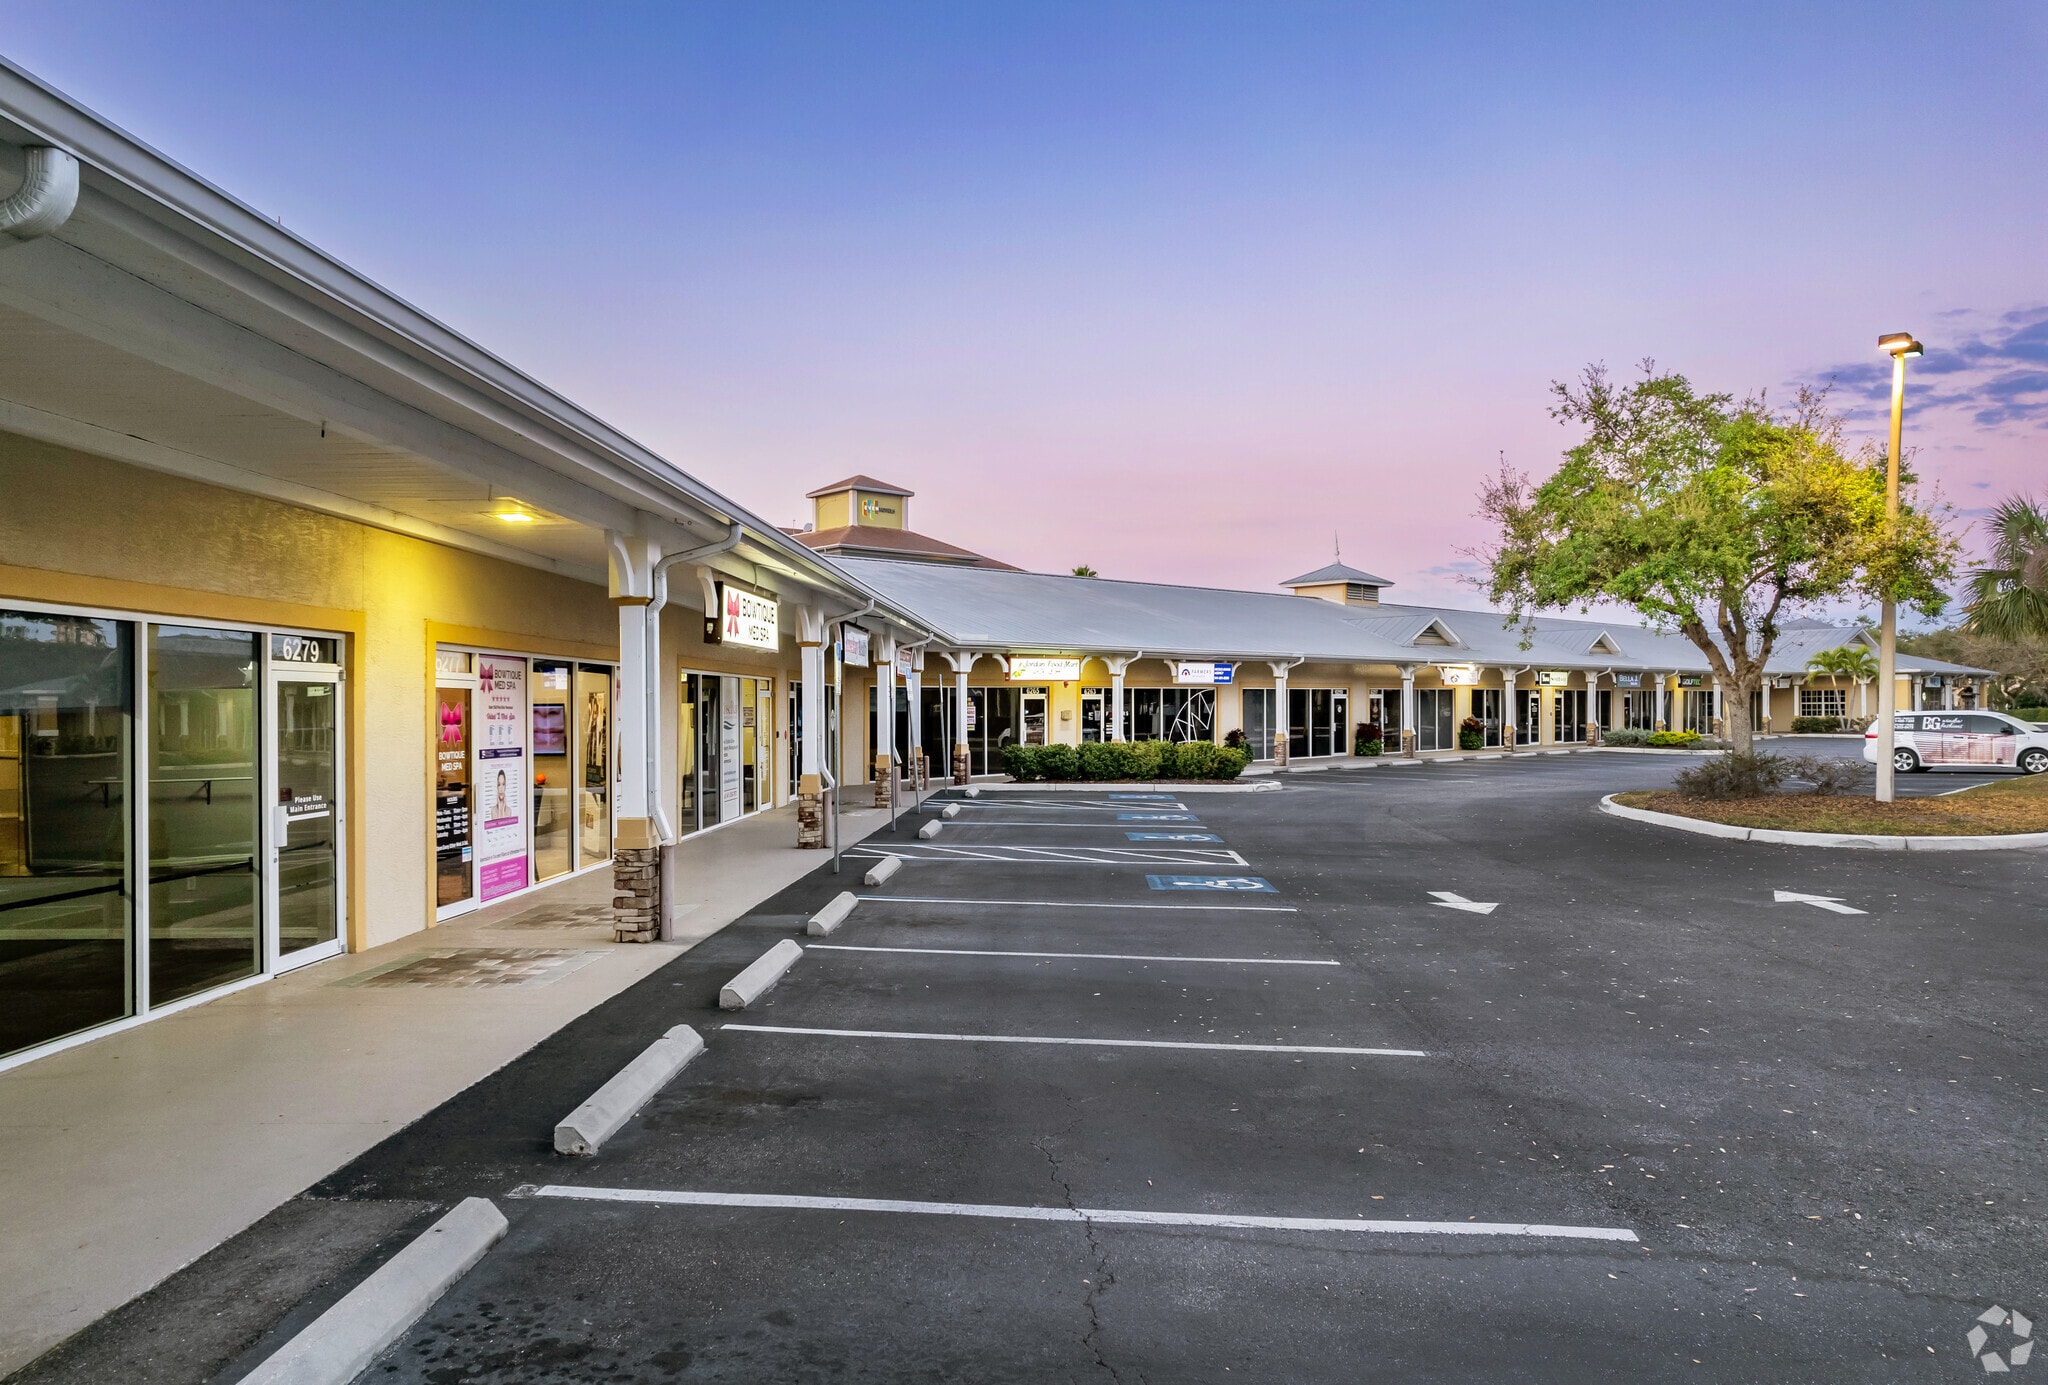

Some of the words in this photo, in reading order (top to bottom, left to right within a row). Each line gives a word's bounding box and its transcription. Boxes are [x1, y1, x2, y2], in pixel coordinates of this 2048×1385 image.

[743, 598, 774, 624] BOWTIQUE
[748, 625, 759, 640] MED
[760, 627, 769, 642] SPA
[283, 638, 319, 662] 6279
[494, 669, 522, 680] BOWTIQUE
[494, 681, 506, 690] MED
[506, 681, 516, 690] SPA
[438, 750, 465, 760] BOWTIQUE
[441, 763, 452, 771] MED
[453, 762, 463, 771] SPA
[294, 796, 312, 804] Please
[290, 805, 303, 813] Main
[304, 803, 327, 811] Entrance
